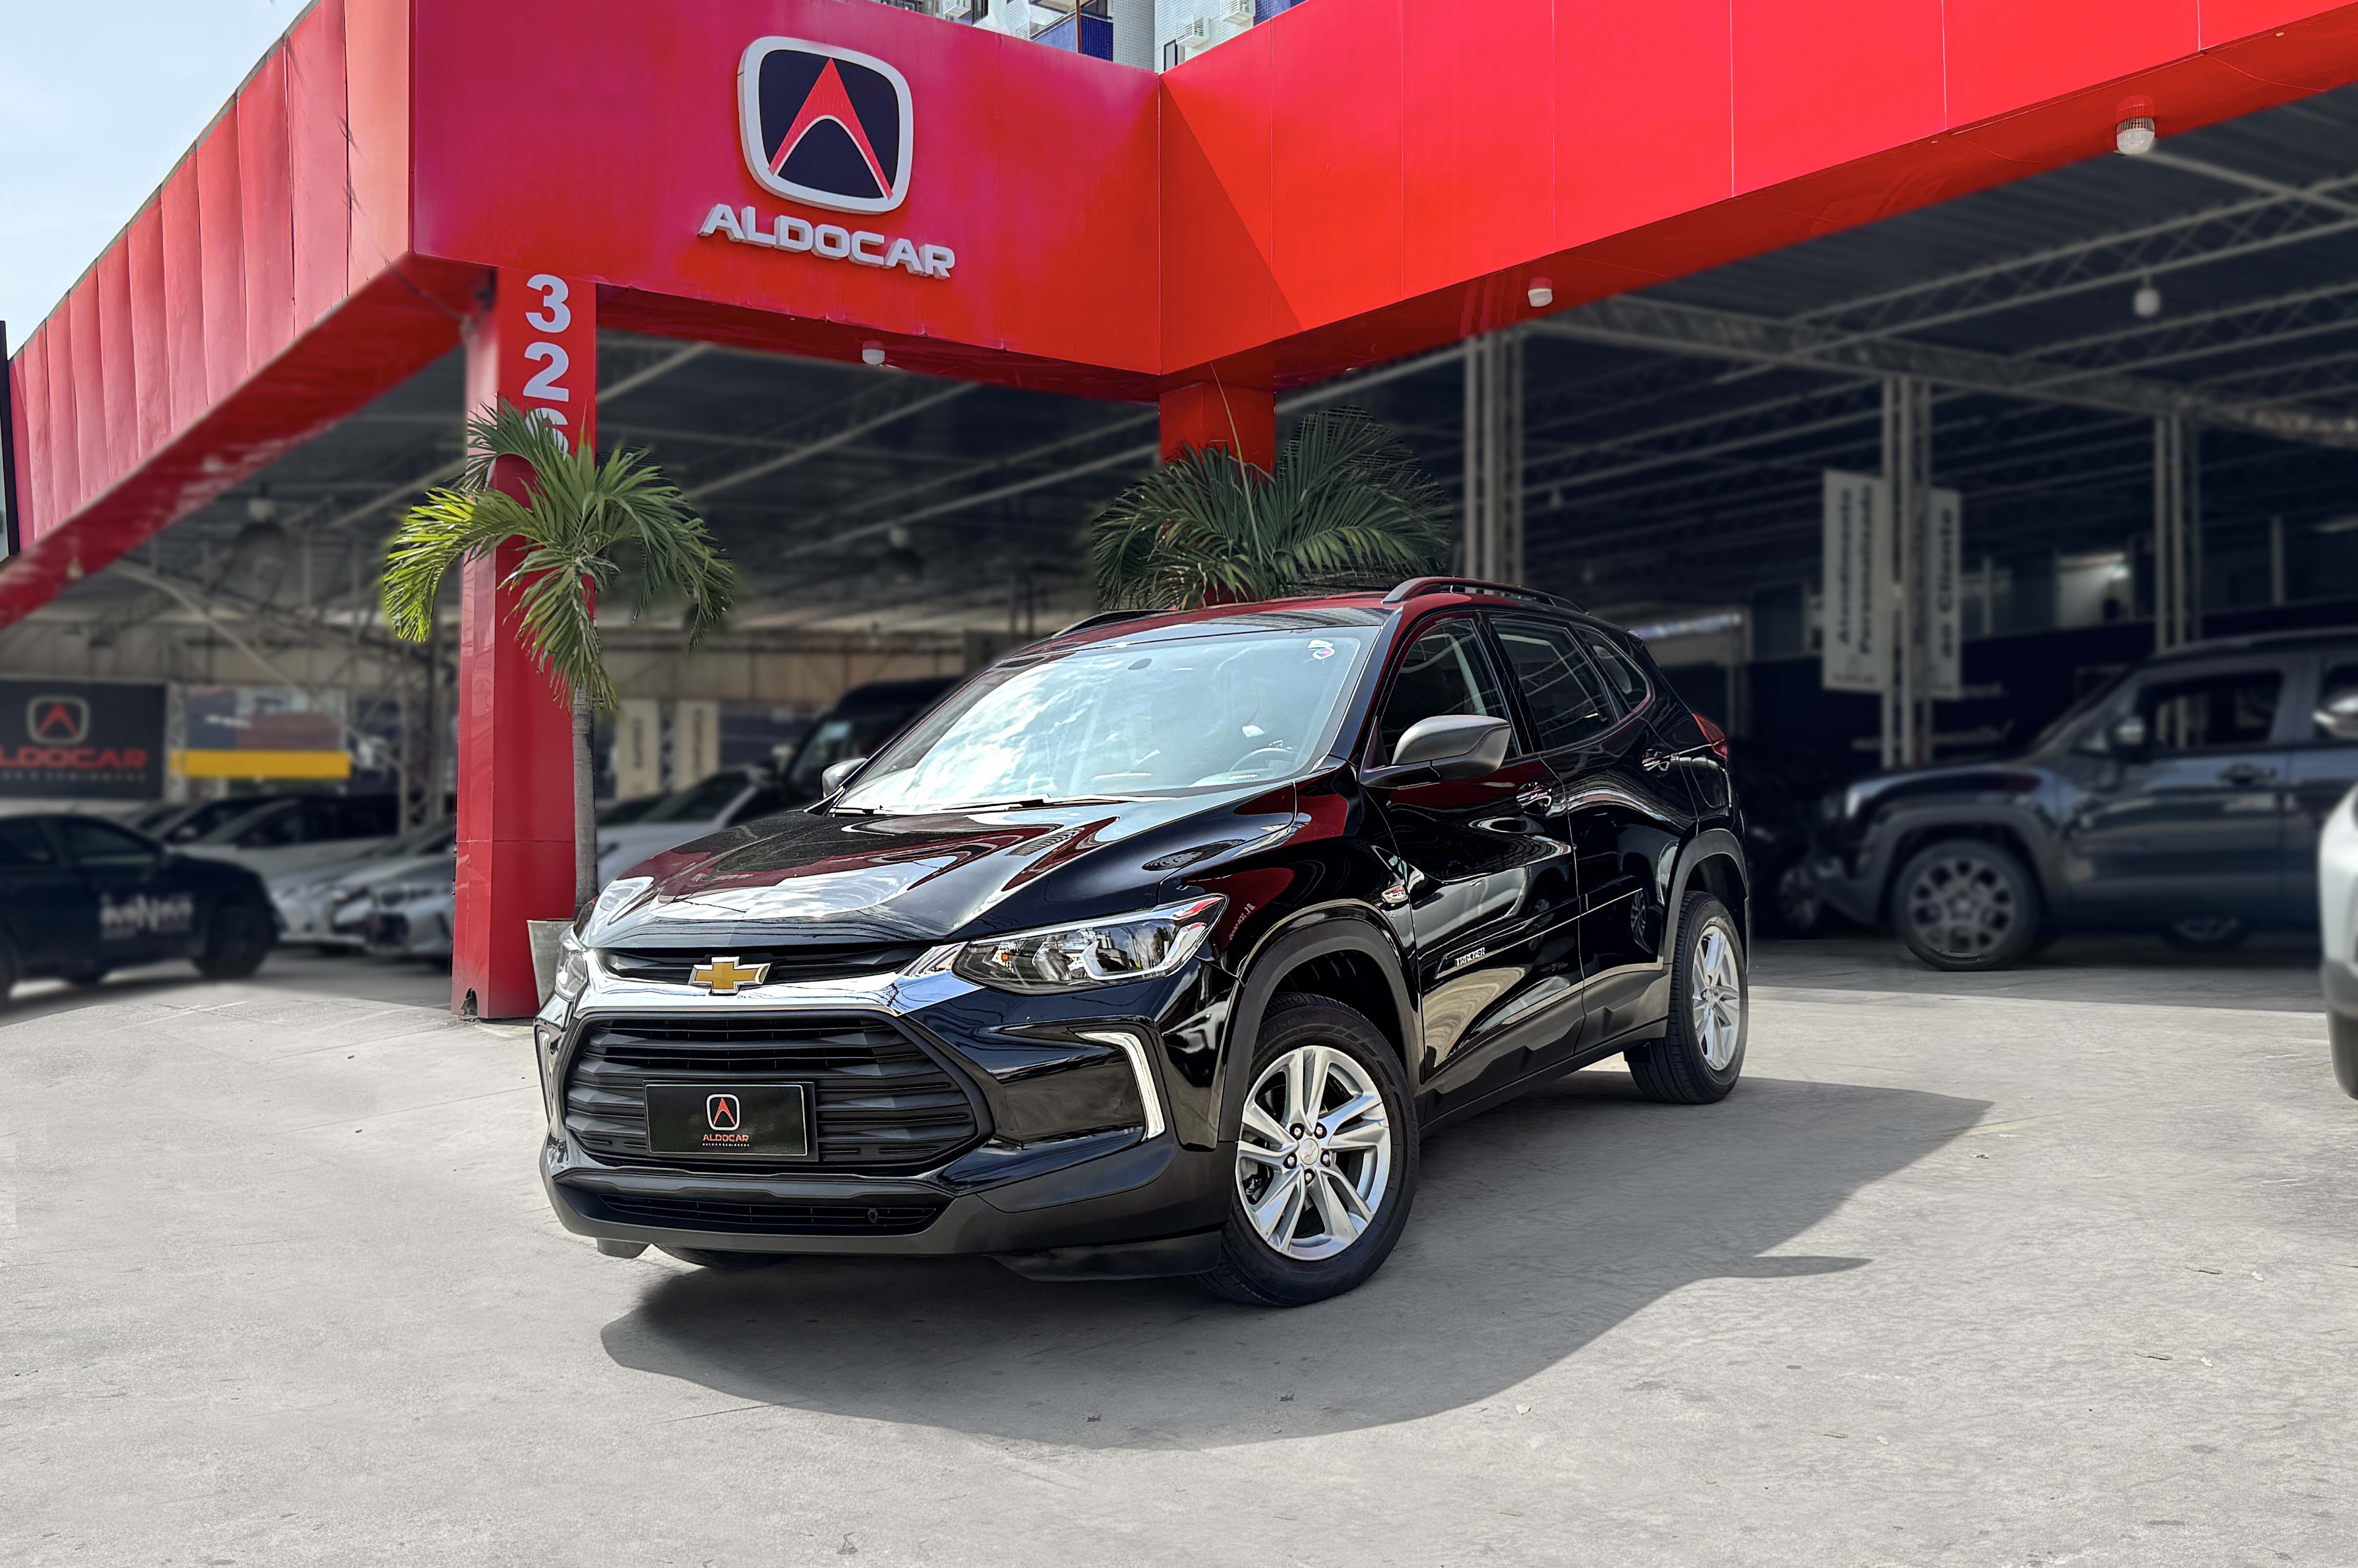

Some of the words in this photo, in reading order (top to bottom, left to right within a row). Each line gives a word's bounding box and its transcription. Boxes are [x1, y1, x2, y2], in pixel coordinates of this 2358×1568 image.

[698, 204, 955, 280] ALDOCAR
[0, 746, 148, 768] LDOCAR
[1455, 947, 1485, 966] TRACKER
[703, 1133, 749, 1142] ALDOCAR
